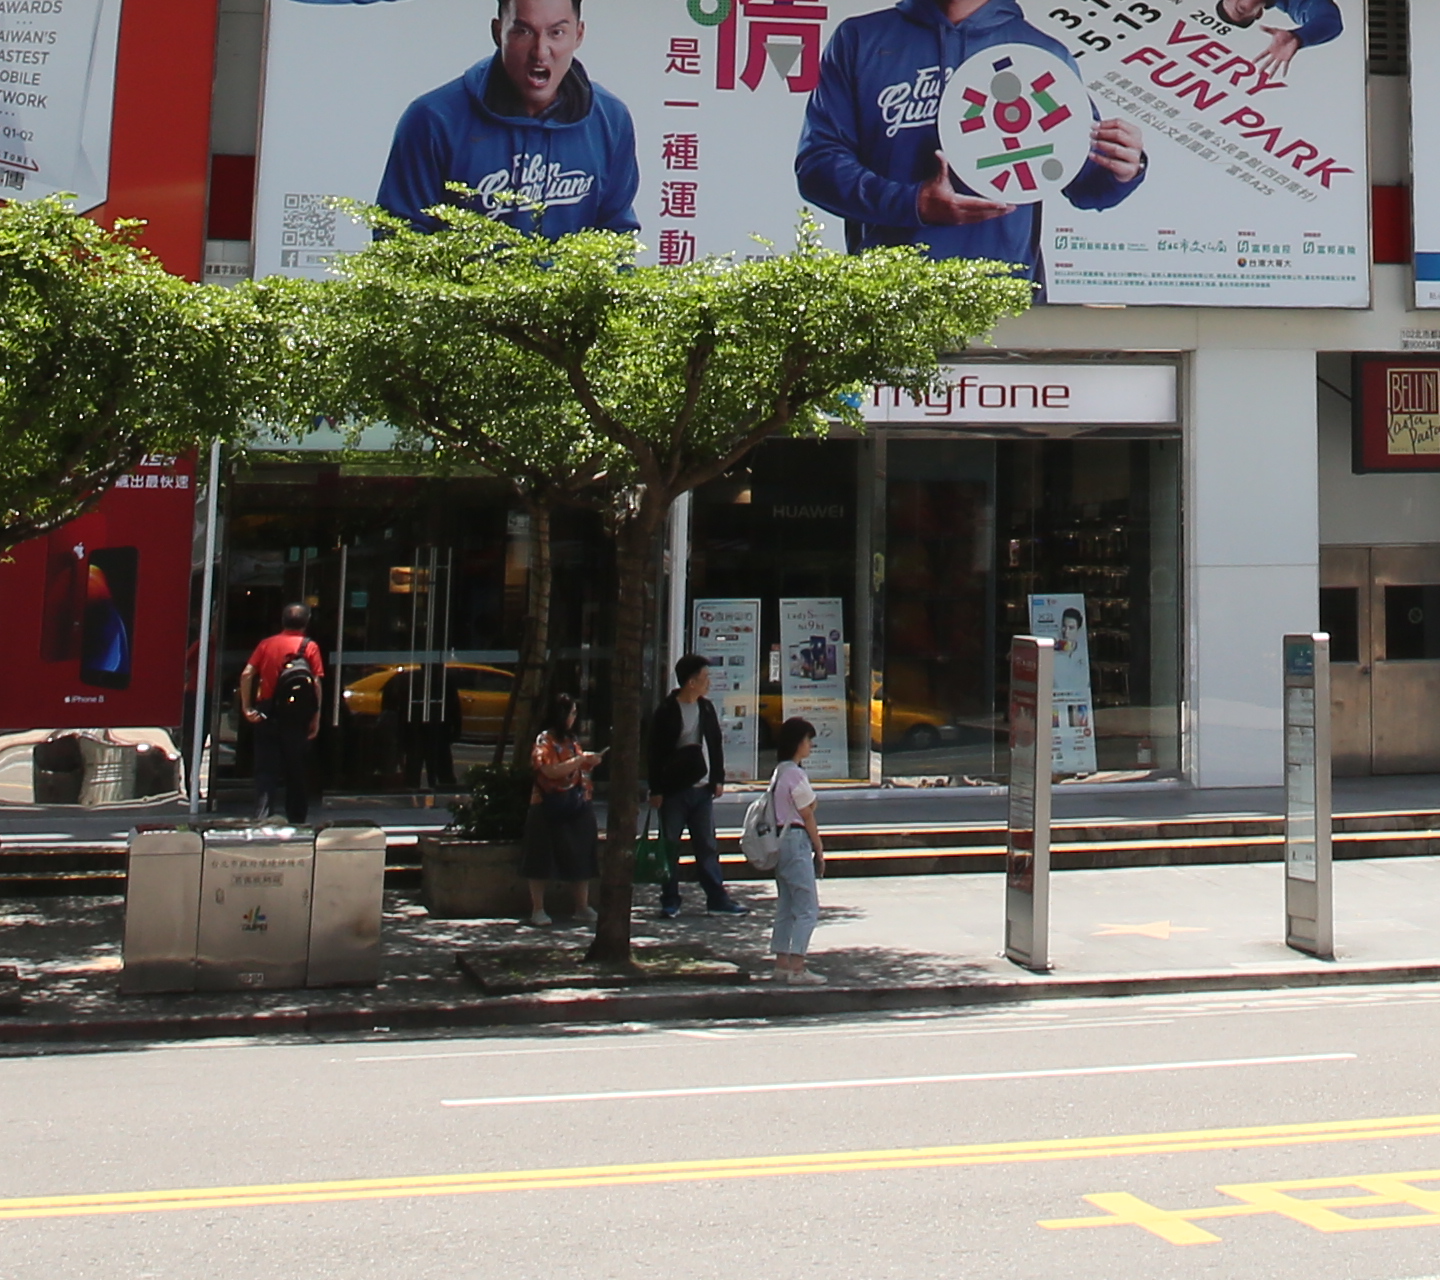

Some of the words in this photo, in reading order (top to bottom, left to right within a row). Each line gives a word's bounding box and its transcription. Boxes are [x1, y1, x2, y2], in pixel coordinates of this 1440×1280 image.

[1189, 9, 1233, 37] 2018
[1167, 19, 1288, 96] VERY
[3, 126, 34, 142] Q1-Q2
[1121, 47, 1228, 111] FUN
[1219, 106, 1355, 190] PARK
[1391, 373, 1437, 413] BELLINI
[772, 504, 845, 520] HUAWEI
